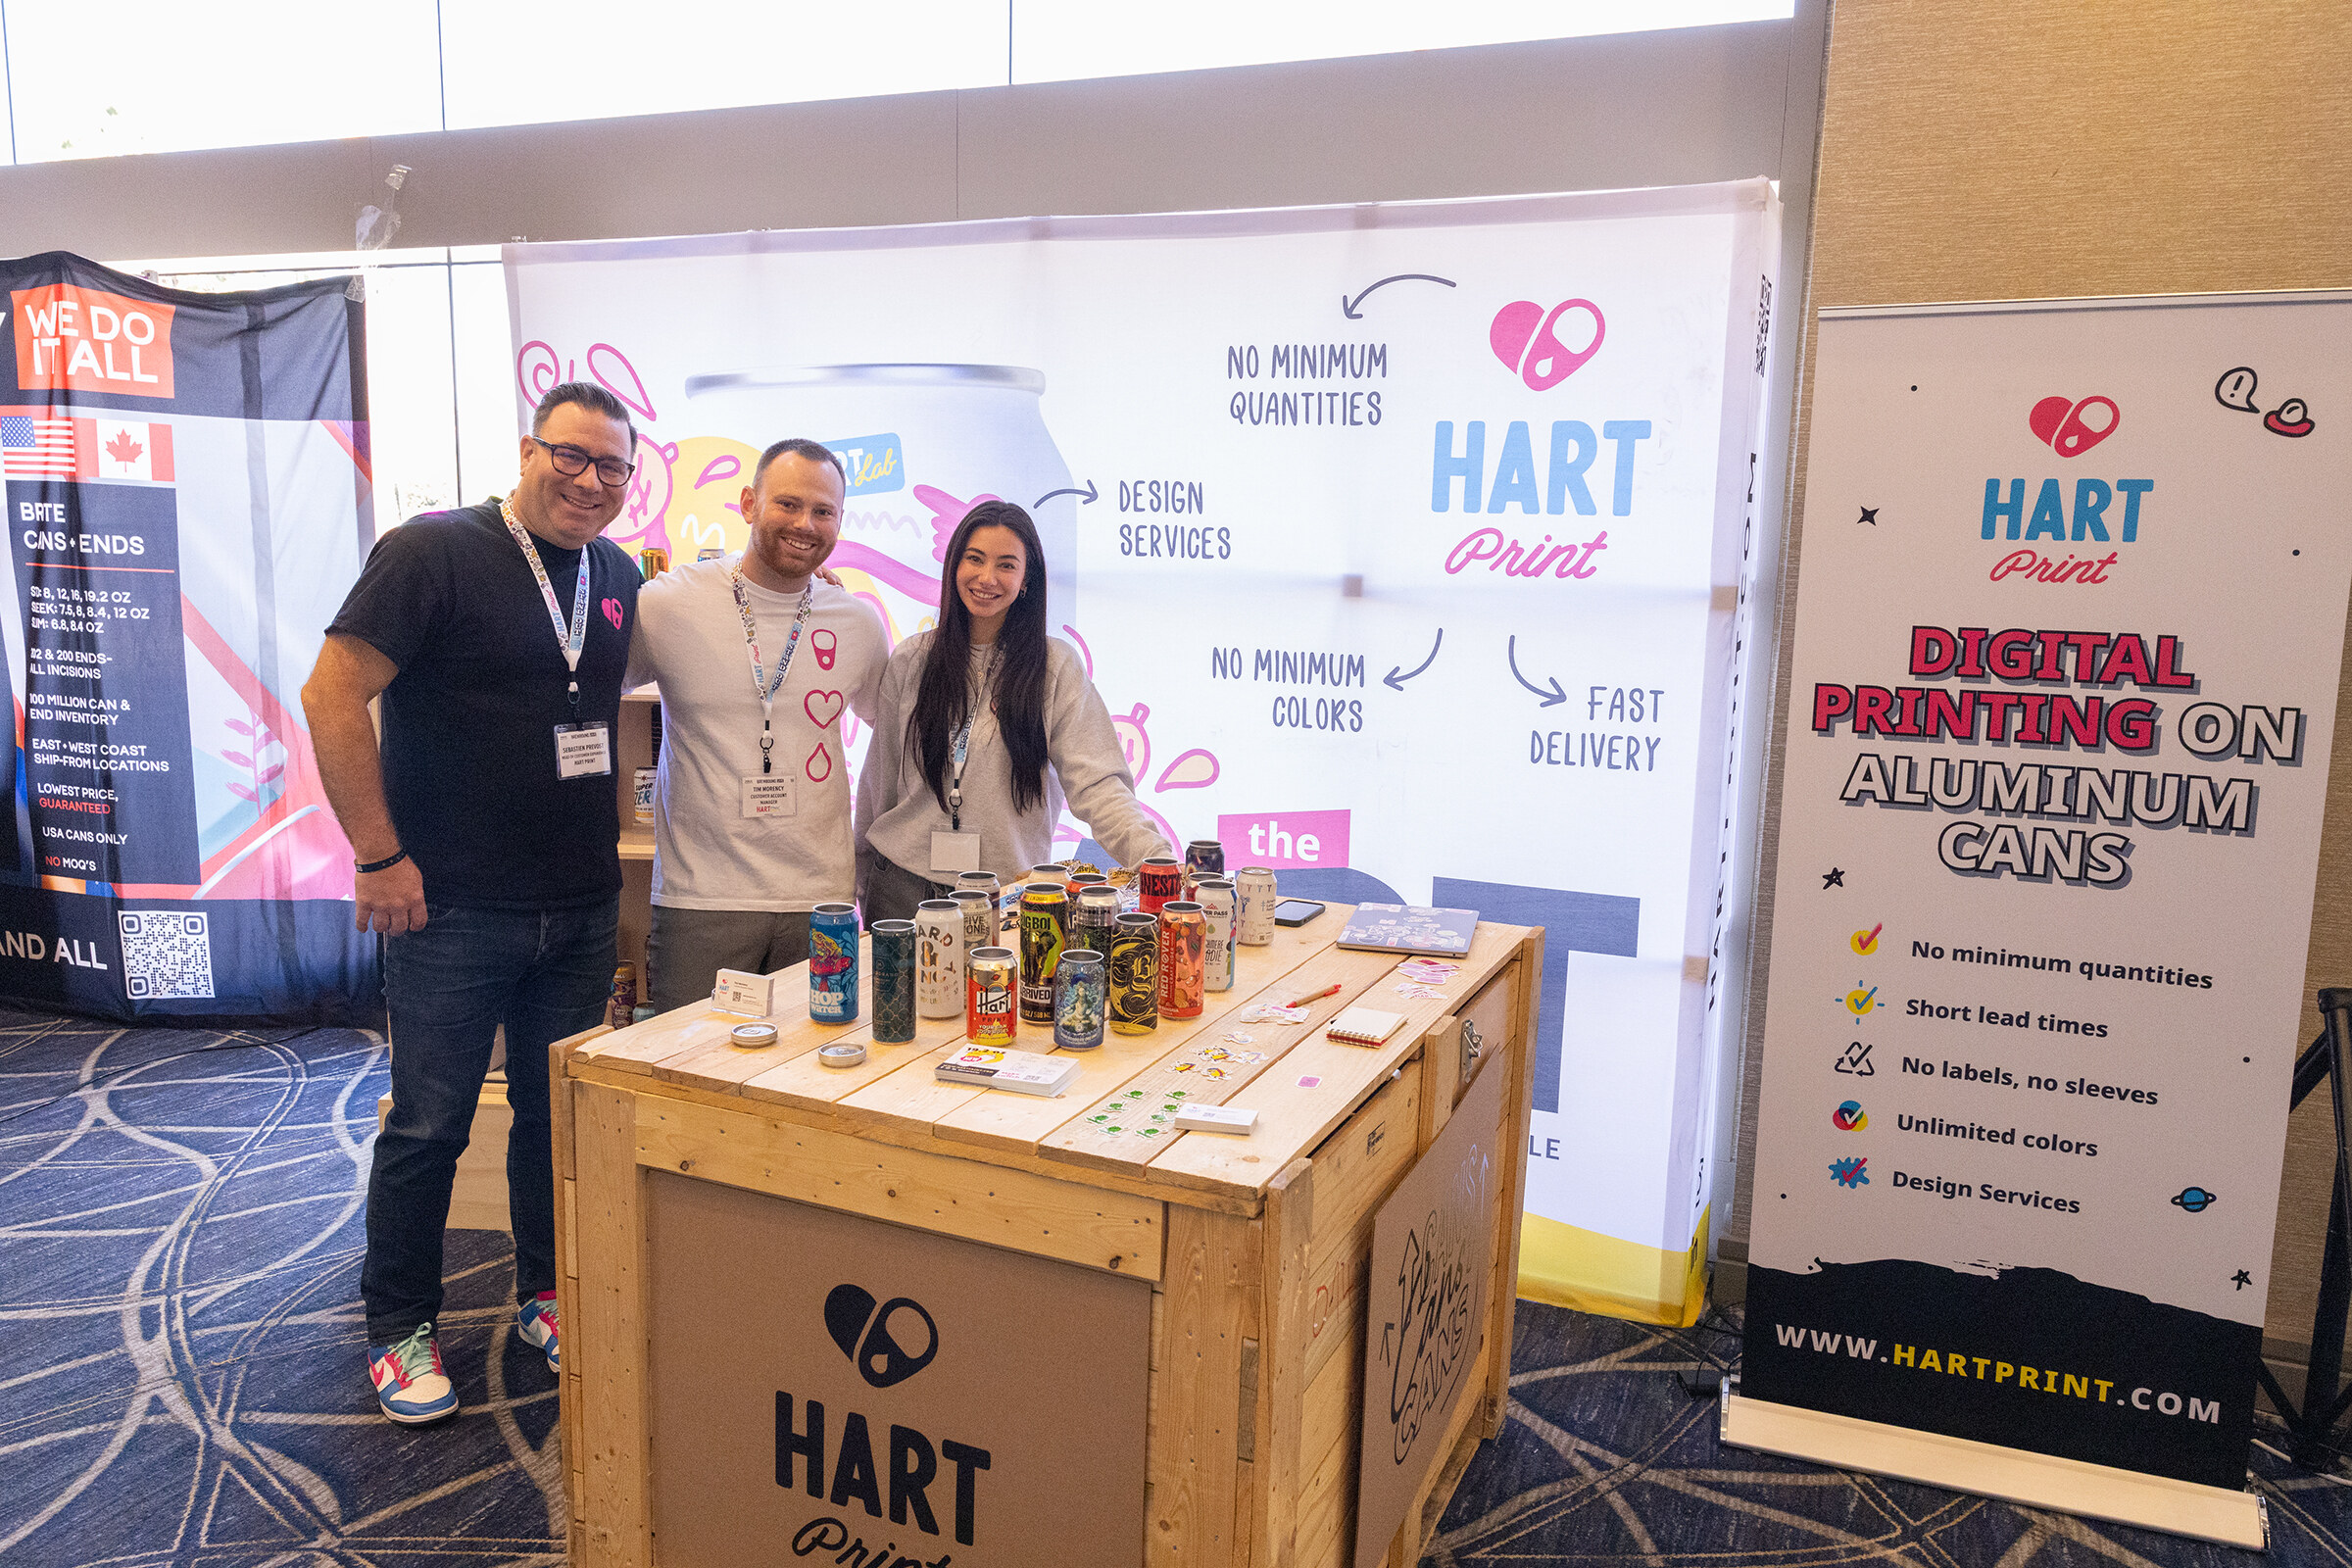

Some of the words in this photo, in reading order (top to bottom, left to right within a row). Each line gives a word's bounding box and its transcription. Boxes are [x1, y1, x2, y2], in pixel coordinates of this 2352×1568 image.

[24, 300, 79, 337] WE
[90, 305, 155, 345] DO
[32, 337, 61, 375] IT
[67, 340, 159, 383] ALL
[1227, 344, 1260, 380] NO
[1271, 343, 1388, 379] MINIMUM
[1230, 390, 1383, 427] QUANTITIES
[1431, 419, 1652, 516] HART
[1119, 480, 1203, 515] DESIGN
[1981, 478, 2154, 543] HART
[79, 534, 145, 556] ENDS
[1120, 524, 1232, 560] SERVICES
[1445, 526, 1608, 580] Print
[1989, 550, 2118, 584] Print
[84, 591, 108, 603] 19.2
[111, 592, 131, 604] OZ
[87, 606, 111, 619] 8.4,
[114, 607, 127, 618] 12
[130, 608, 150, 619] OZ
[86, 622, 105, 633] OZ
[30, 663, 45, 675] ALL
[48, 664, 102, 679] INCISIONS
[45, 649, 54, 661] &
[57, 650, 74, 662] 200
[1212, 647, 1243, 680] NO
[1253, 650, 1365, 688] MINIMUM
[1909, 625, 2196, 690] DIGITAL
[29, 694, 45, 705] 100
[47, 695, 87, 709] MILLION
[88, 699, 117, 710] CAN
[121, 700, 130, 710] &
[30, 709, 53, 720] END
[55, 710, 119, 725] INVENTORY
[1272, 695, 1364, 734] COLORS
[1587, 686, 1665, 724] FAST
[1812, 683, 2160, 754] PRINTING
[2178, 702, 2304, 764] ON
[32, 738, 61, 750] EAST
[69, 741, 97, 755] WEST
[100, 744, 147, 757] COAST
[34, 754, 91, 768] SHIP-FROM
[93, 760, 170, 772] LOCATIONS
[1531, 730, 1662, 772] DELIVERY
[37, 782, 79, 797] LOWEST
[82, 788, 119, 802] PRICE,
[39, 797, 111, 814] GUARANTEED
[1840, 753, 2257, 833] ALUMINUM
[42, 826, 64, 840] USA
[66, 829, 94, 842] CANS
[96, 833, 128, 845] ONLY
[1248, 820, 1320, 861] the
[45, 856, 61, 867] NO
[63, 858, 96, 871] MOQ'S
[1937, 820, 2132, 889] CANS
[916, 924, 954, 947] ARD
[964, 924, 990, 936] ONES
[0, 930, 46, 960] ND
[54, 938, 108, 970] ALL
[1911, 940, 1945, 961] No
[1951, 947, 2072, 974] minimum
[2079, 958, 2214, 991] quantities
[810, 989, 844, 1005] HOP
[978, 985, 1011, 1016] Hart
[1160, 975, 1169, 998] RED
[1906, 999, 1972, 1024] Short
[1978, 1005, 2031, 1029] lead
[2036, 1013, 2109, 1039] times
[1901, 1056, 1936, 1076] No
[1941, 1059, 2020, 1090] labels,
[2027, 1071, 2059, 1092] no
[2064, 1076, 2160, 1106] sleeves
[1896, 1113, 2016, 1146] Unlimited
[2022, 1133, 2099, 1158] colors
[1892, 1171, 1973, 1200] Design
[1979, 1184, 2082, 1214] Services
[1775, 1324, 2222, 1424] WWW.HARTPRINT.COM
[775, 1390, 992, 1546] HART
